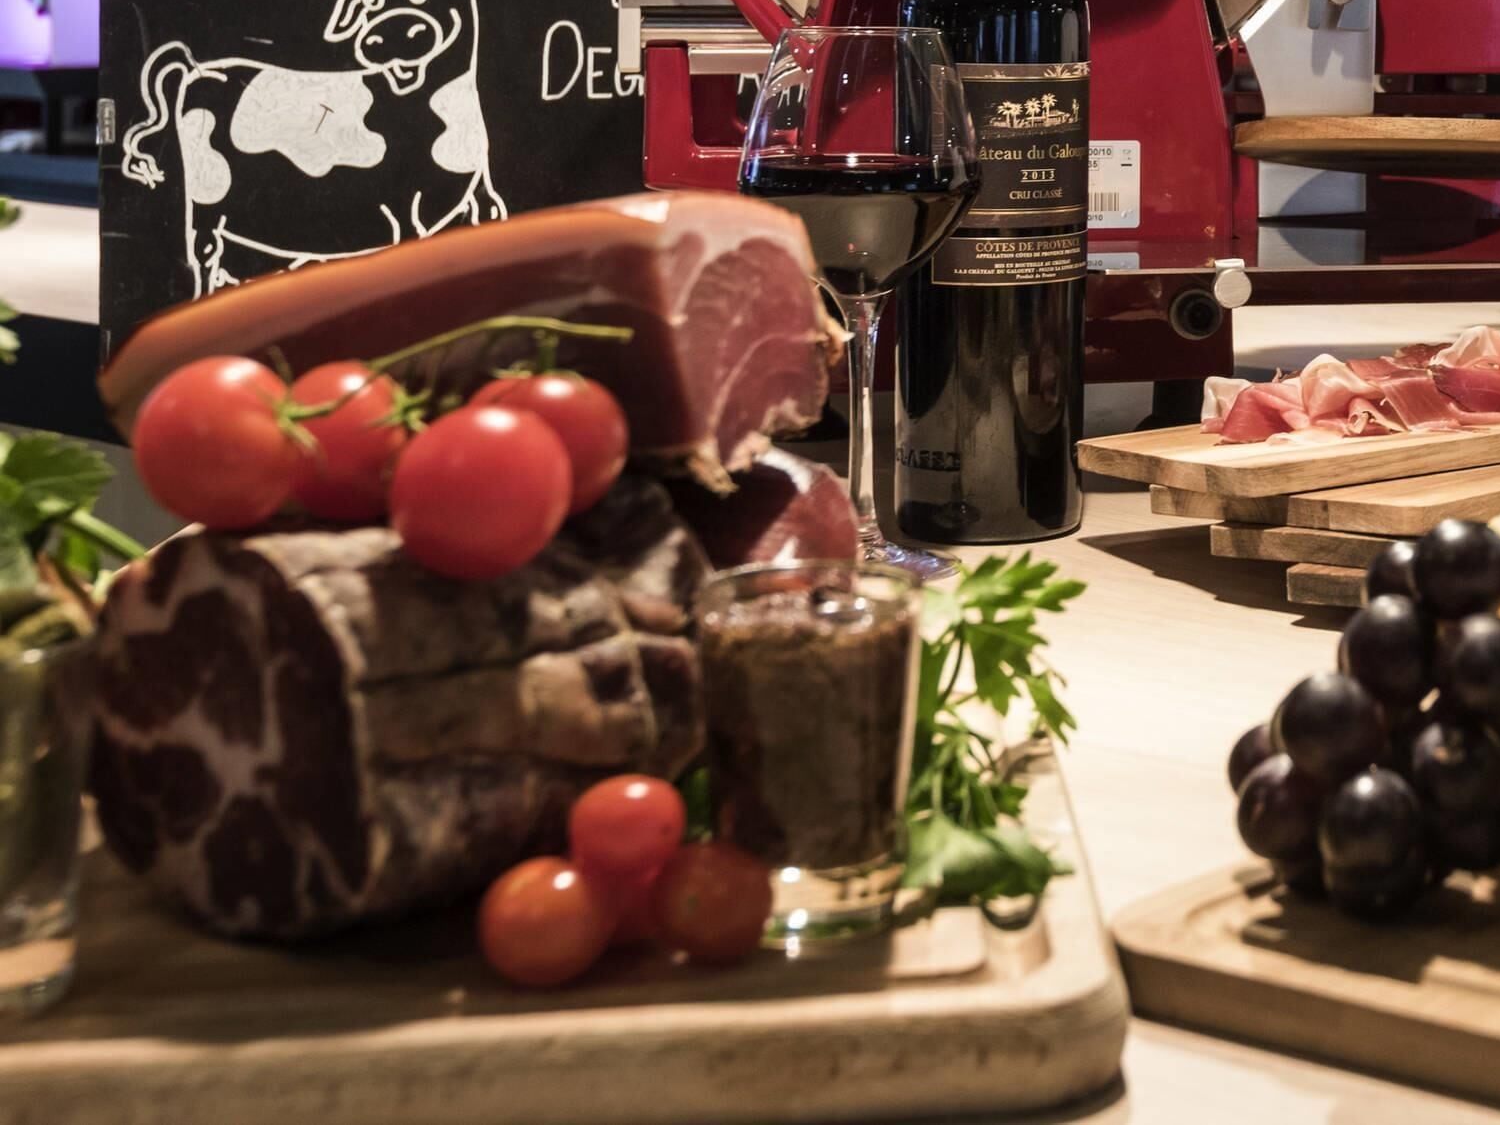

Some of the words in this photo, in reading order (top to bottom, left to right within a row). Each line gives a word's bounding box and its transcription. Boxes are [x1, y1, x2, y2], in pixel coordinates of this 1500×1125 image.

[979, 146, 1022, 161] âteau
[1027, 145, 1045, 160] du
[1022, 171, 1055, 180] 2013
[1009, 190, 1031, 200] CRU
[976, 241, 1015, 252] CÔTES
[1019, 242, 1033, 251] DE
